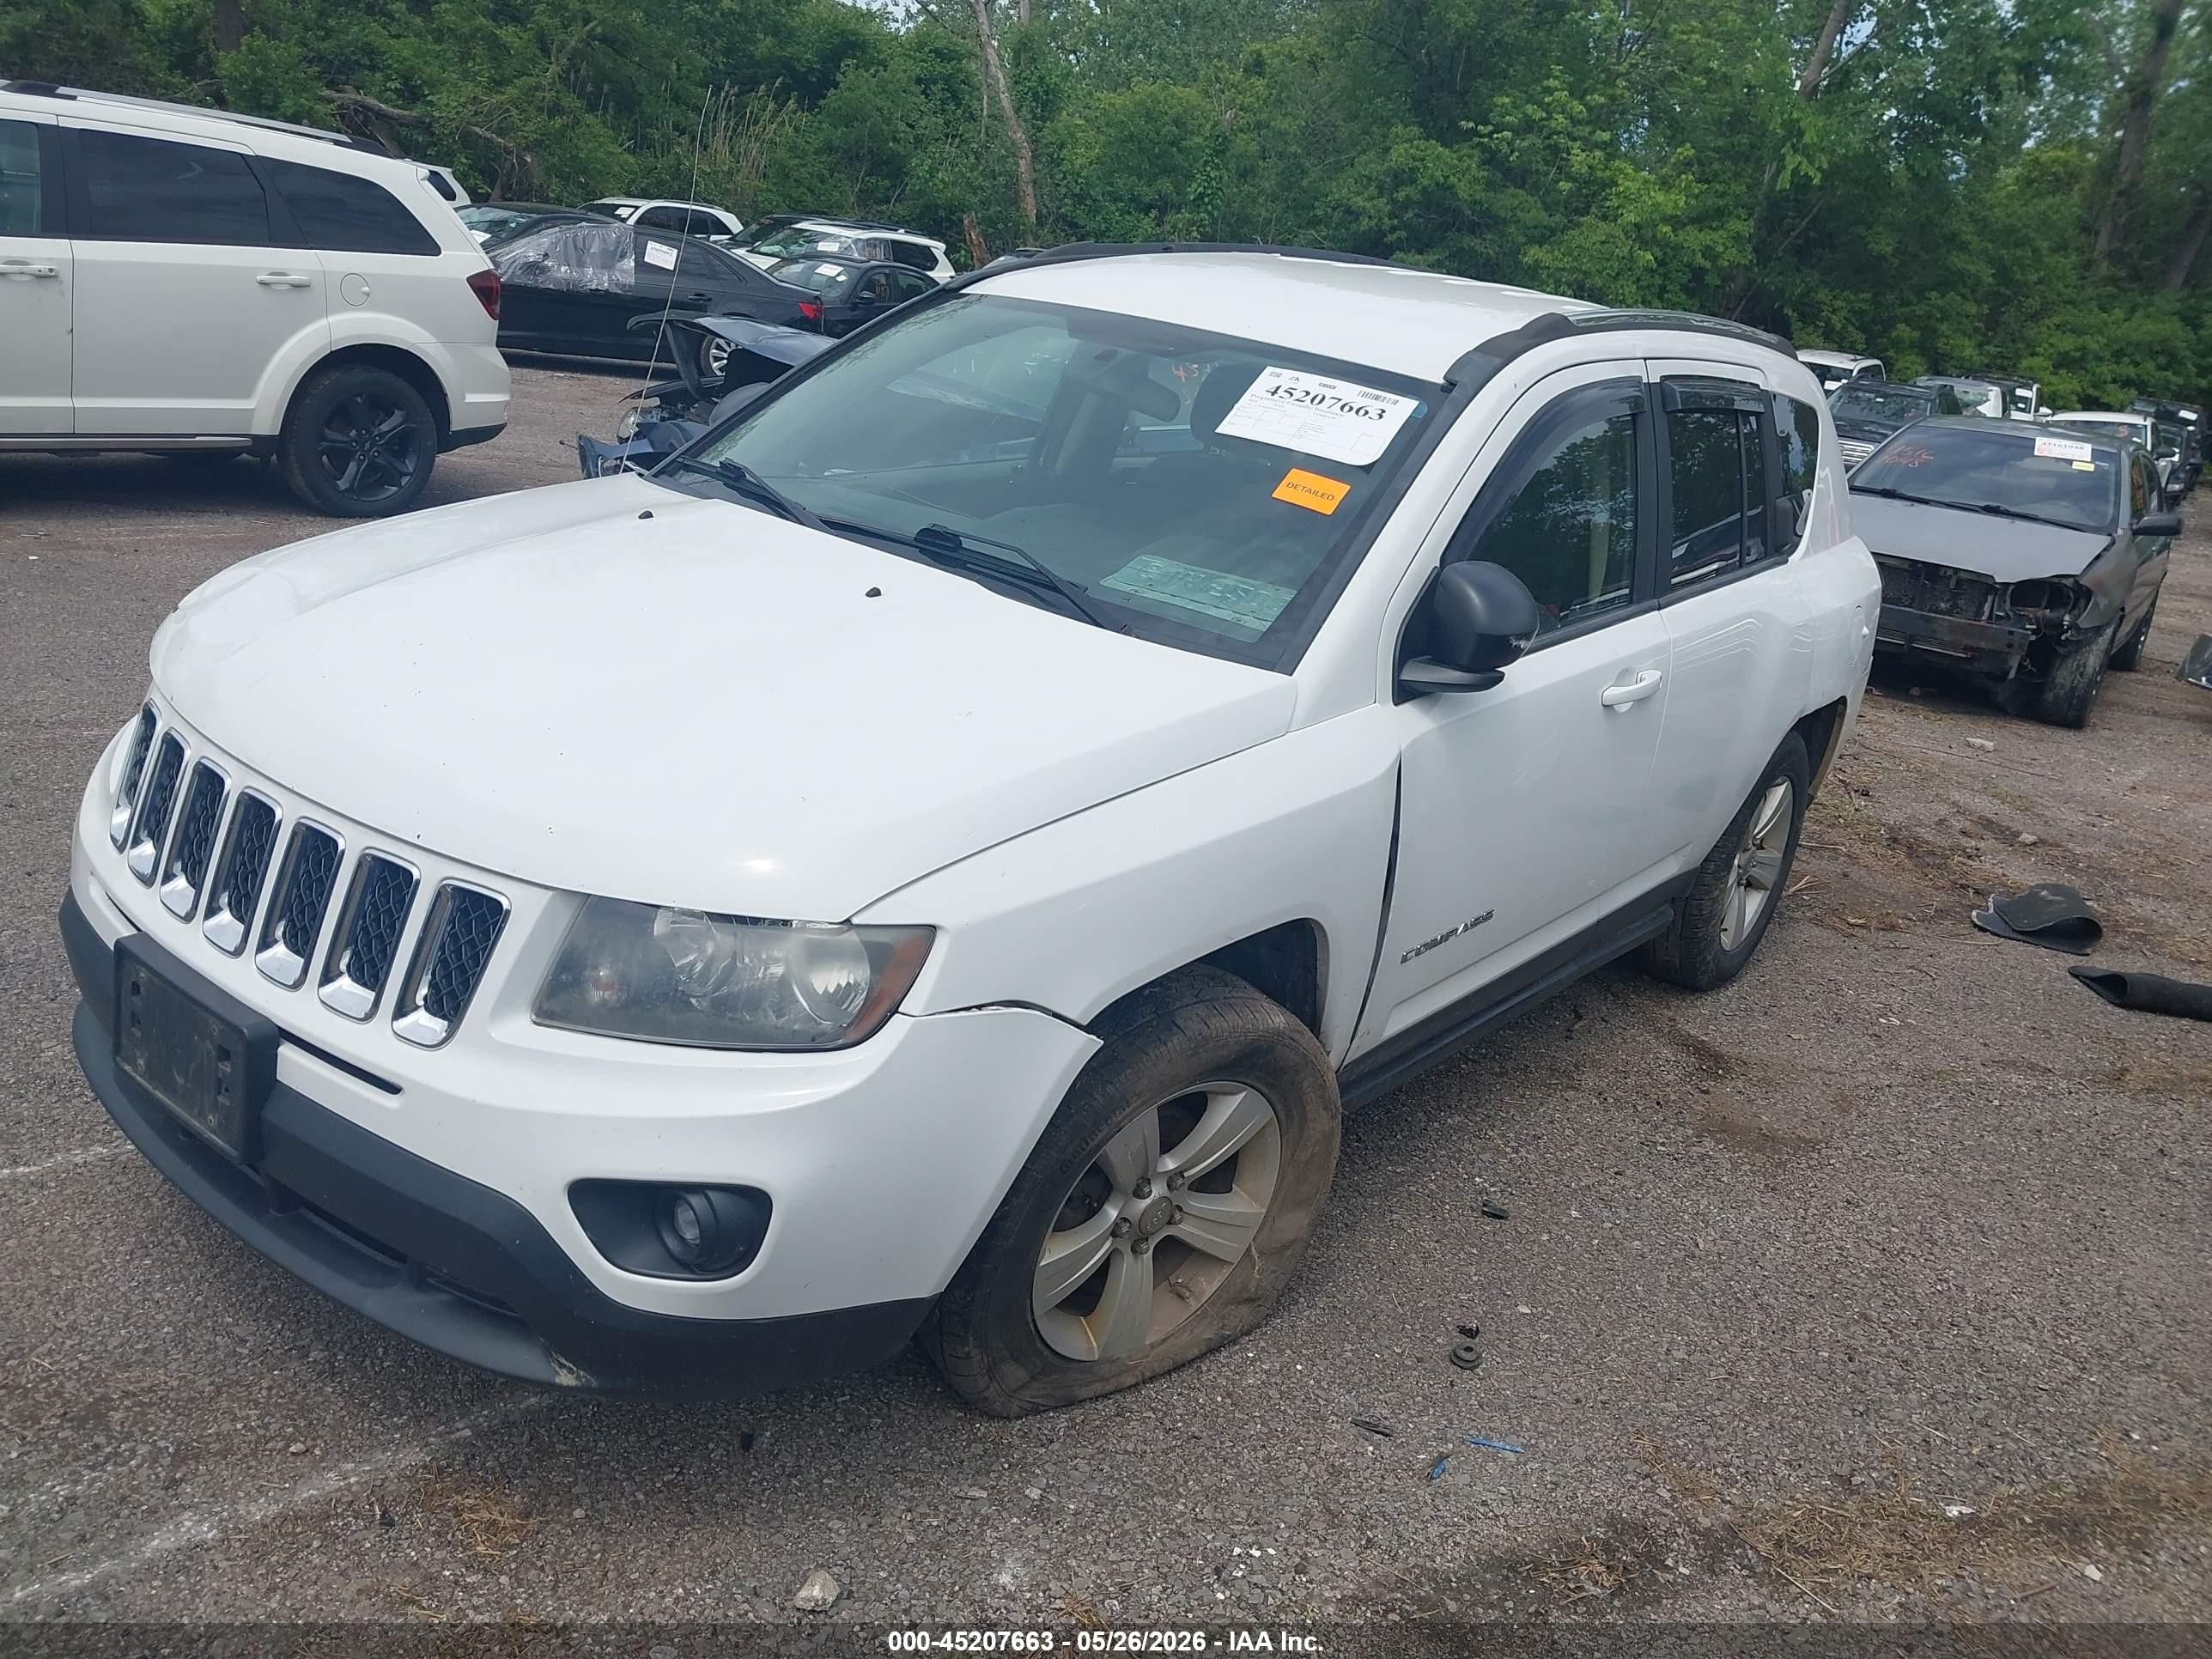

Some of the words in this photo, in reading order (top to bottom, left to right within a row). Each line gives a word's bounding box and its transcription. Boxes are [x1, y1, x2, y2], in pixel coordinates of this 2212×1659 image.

[1265, 384, 1387, 422] 45207663
[1285, 481, 1335, 502] DETAILED
[1400, 907, 1496, 965] COMPASS
